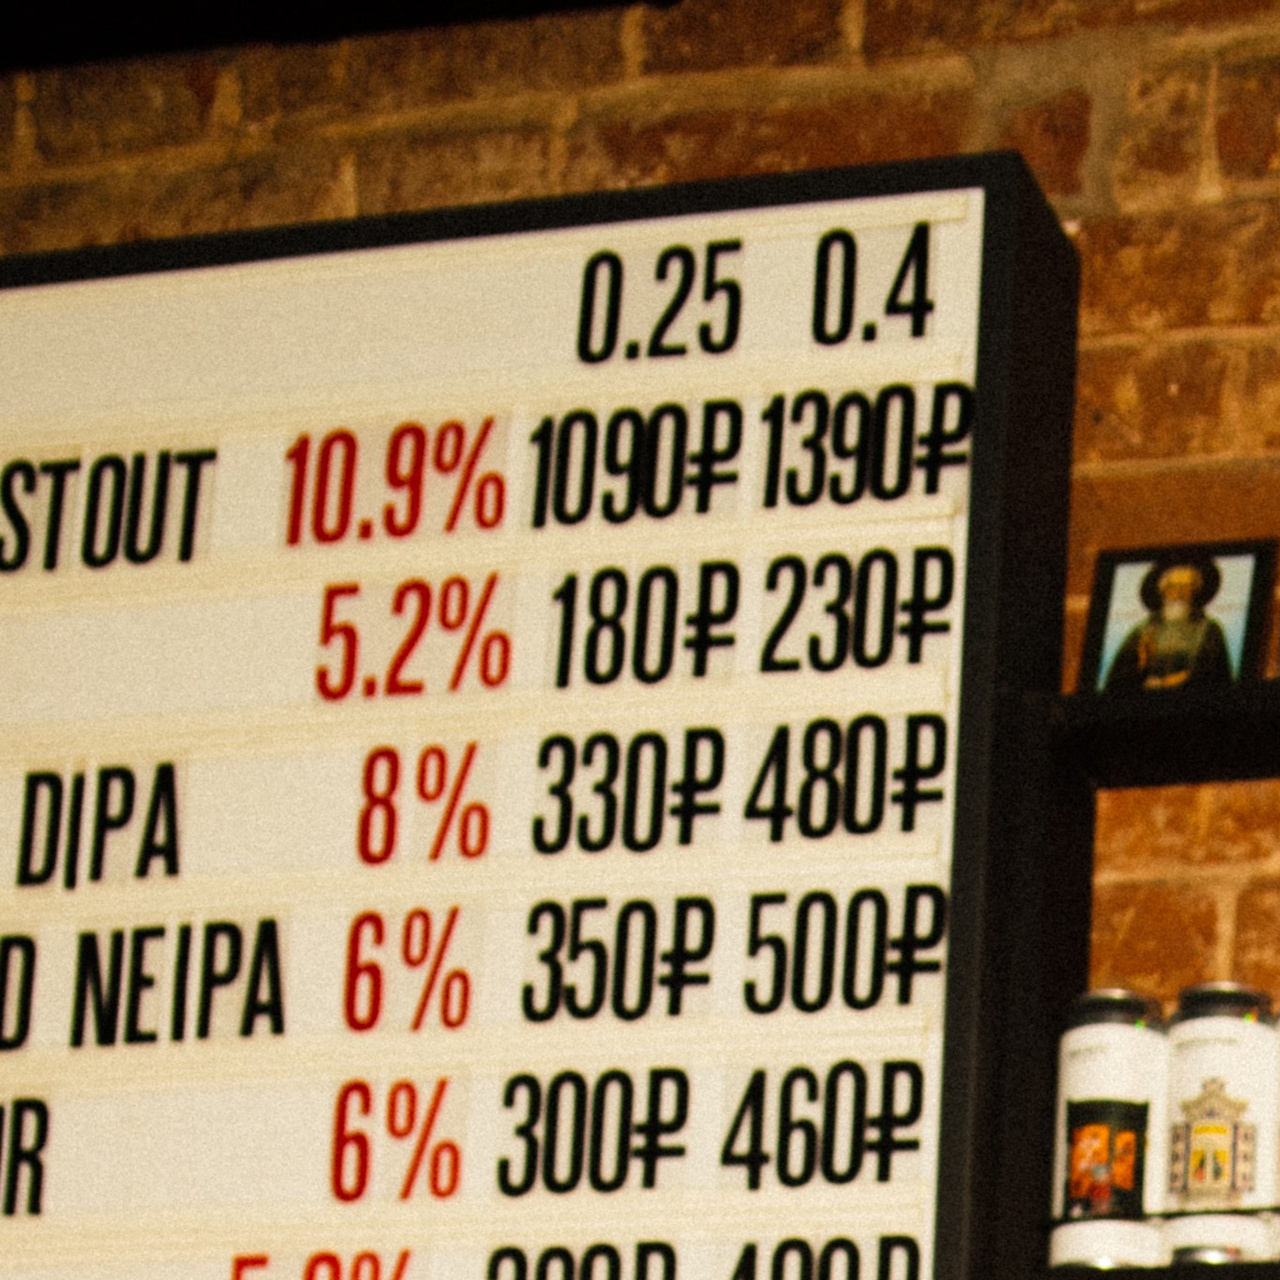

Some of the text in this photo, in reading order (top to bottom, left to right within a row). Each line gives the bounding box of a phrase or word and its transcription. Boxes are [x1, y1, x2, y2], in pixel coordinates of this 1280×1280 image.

[577, 221, 935, 366] 0.25 0.4
[0, 448, 218, 575] STOUT
[285, 417, 506, 547] 10.9%
[316, 573, 511, 702] 5.2%
[16, 762, 180, 891] DIPA
[70, 918, 285, 1049] NEIPA
[0, 1097, 50, 1217] R
